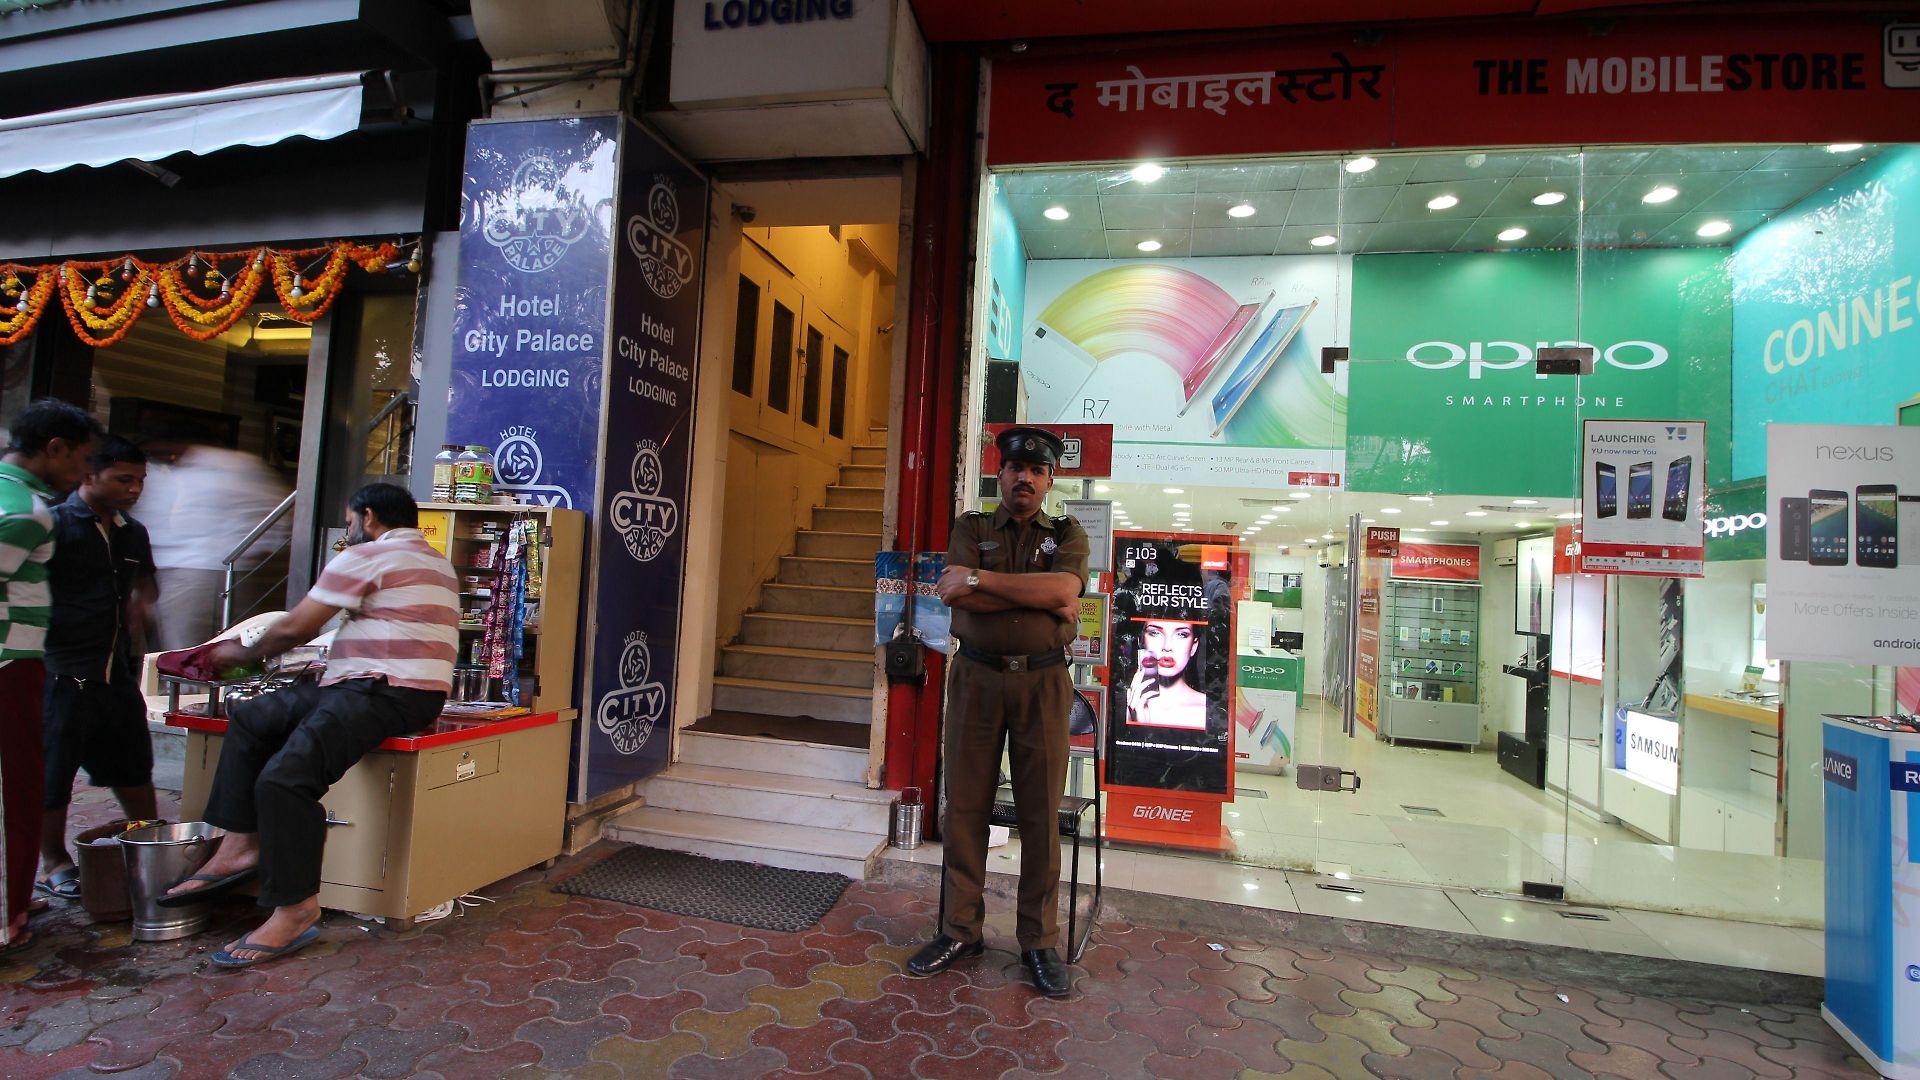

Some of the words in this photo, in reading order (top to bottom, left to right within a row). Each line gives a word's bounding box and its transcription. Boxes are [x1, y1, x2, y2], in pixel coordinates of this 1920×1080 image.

[704, 0, 854, 31] LODGING
[1473, 59, 1549, 95] THE
[1045, 81, 1079, 118] द
[518, 146, 556, 162] HOTEL
[504, 245, 565, 270] PALACE
[631, 222, 688, 275] CITY
[641, 260, 680, 296] PALACE
[499, 294, 560, 317] Hotel
[641, 312, 675, 346] Hotel
[1763, 275, 1920, 375] CONNE
[463, 329, 508, 358] City
[516, 328, 594, 353] Palace
[618, 336, 647, 370] City
[649, 347, 690, 383] Palace
[481, 368, 570, 389] LODGING
[628, 376, 677, 407] LODGING
[1446, 395, 1625, 408] SMARTPHONE
[1082, 398, 1110, 419] R7
[499, 425, 538, 442] HOTEL
[1134, 423, 1151, 432] with
[1152, 424, 1173, 433] Metal
[635, 438, 662, 456] HOTEL
[1590, 434, 1656, 444] LAUNCHING
[1591, 447, 1603, 455] YU
[1642, 448, 1657, 456] You
[1815, 444, 1894, 462] nexus
[614, 498, 674, 530] CITY
[1370, 530, 1397, 541] PUSH
[625, 534, 666, 559] PALACE
[1126, 547, 1157, 560] F103
[1400, 555, 1472, 567] SMARTPHONES
[1142, 583, 1203, 597] REFLECTS
[1136, 594, 1169, 607] YOUR
[1171, 596, 1209, 609] STYLE
[1794, 602, 1829, 616] More
[1833, 603, 1874, 618] Offers
[1878, 606, 1918, 620] Inside
[623, 630, 648, 646] HOTEL
[1241, 665, 1286, 675] oppo
[601, 690, 661, 728] CITY
[612, 723, 652, 752] PALACE
[1630, 733, 1678, 763] SAMSUN
